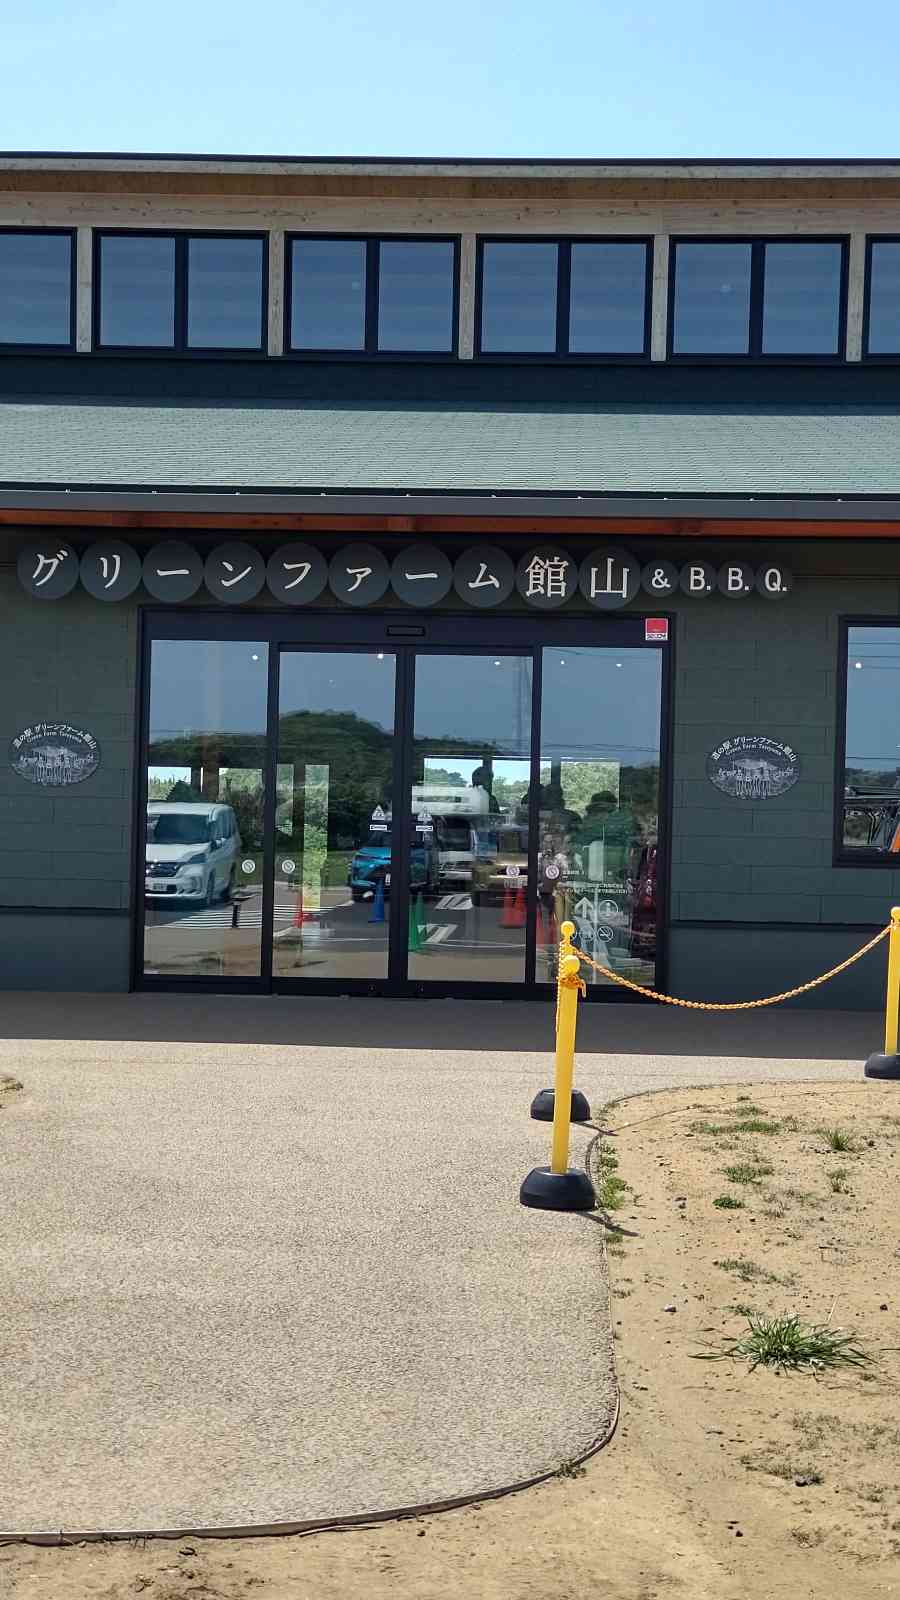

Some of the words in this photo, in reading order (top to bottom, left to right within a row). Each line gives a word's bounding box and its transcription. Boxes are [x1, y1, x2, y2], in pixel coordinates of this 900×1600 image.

[32, 549, 630, 599] グリーンファーム館山
